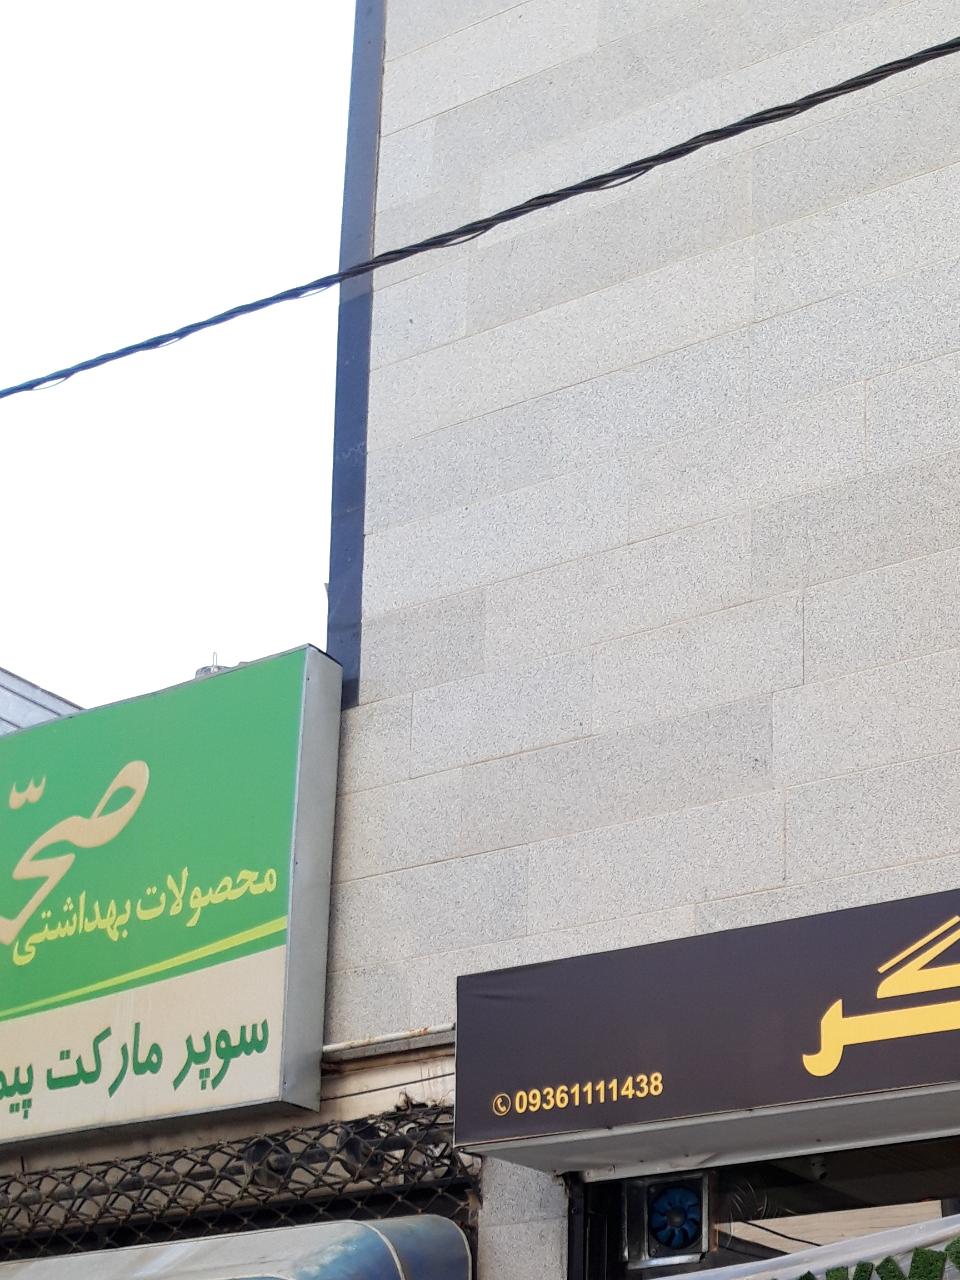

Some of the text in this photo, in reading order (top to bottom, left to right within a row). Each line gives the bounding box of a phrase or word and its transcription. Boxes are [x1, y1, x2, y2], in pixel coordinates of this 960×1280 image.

[11, 865, 277, 967] محصولات بهداشتی
[46, 1021, 163, 1099] مارکت
[172, 1017, 269, 1091] سوپر
[514, 1071, 664, 1115] 09361111438
